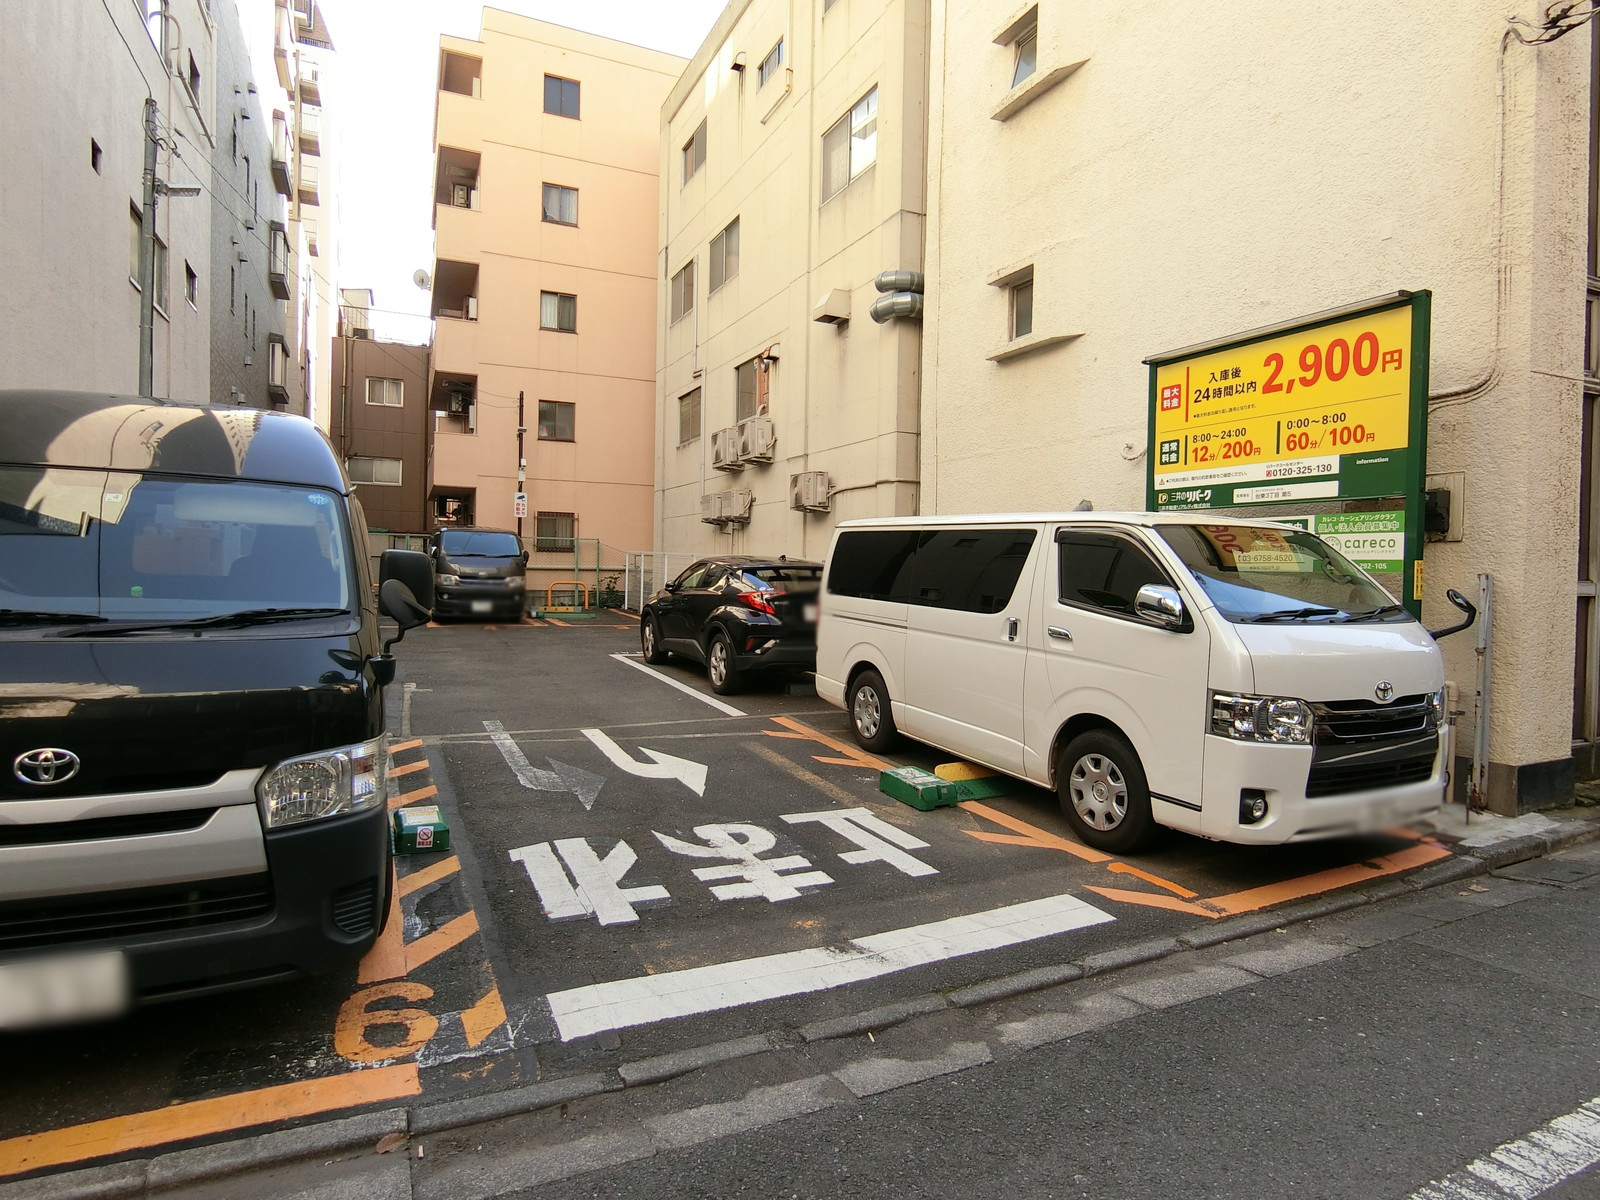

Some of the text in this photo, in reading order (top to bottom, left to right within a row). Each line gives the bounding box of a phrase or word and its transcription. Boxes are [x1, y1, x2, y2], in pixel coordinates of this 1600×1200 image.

[1261, 331, 1403, 395] 2,900円
[1208, 366, 1242, 383] 入庫後
[1163, 386, 1180, 399] 最大
[1193, 380, 1257, 403] 24時間以内
[1163, 397, 1180, 408] 料金
[1161, 441, 1179, 453] 通常
[1161, 451, 1179, 463] 料金
[1356, 456, 1389, 465] information
[1272, 463, 1332, 477] 0120-325-130
[1170, 489, 1212, 502] 三井のリパーク
[1321, 513, 1396, 523] カレコ・カーシェアリングクラブ
[1317, 520, 1400, 533] 個人・法人会員募集中
[1344, 538, 1396, 549] careco
[1242, 554, 1294, 562] 03-6758-4520
[334, 982, 439, 1063] 6
